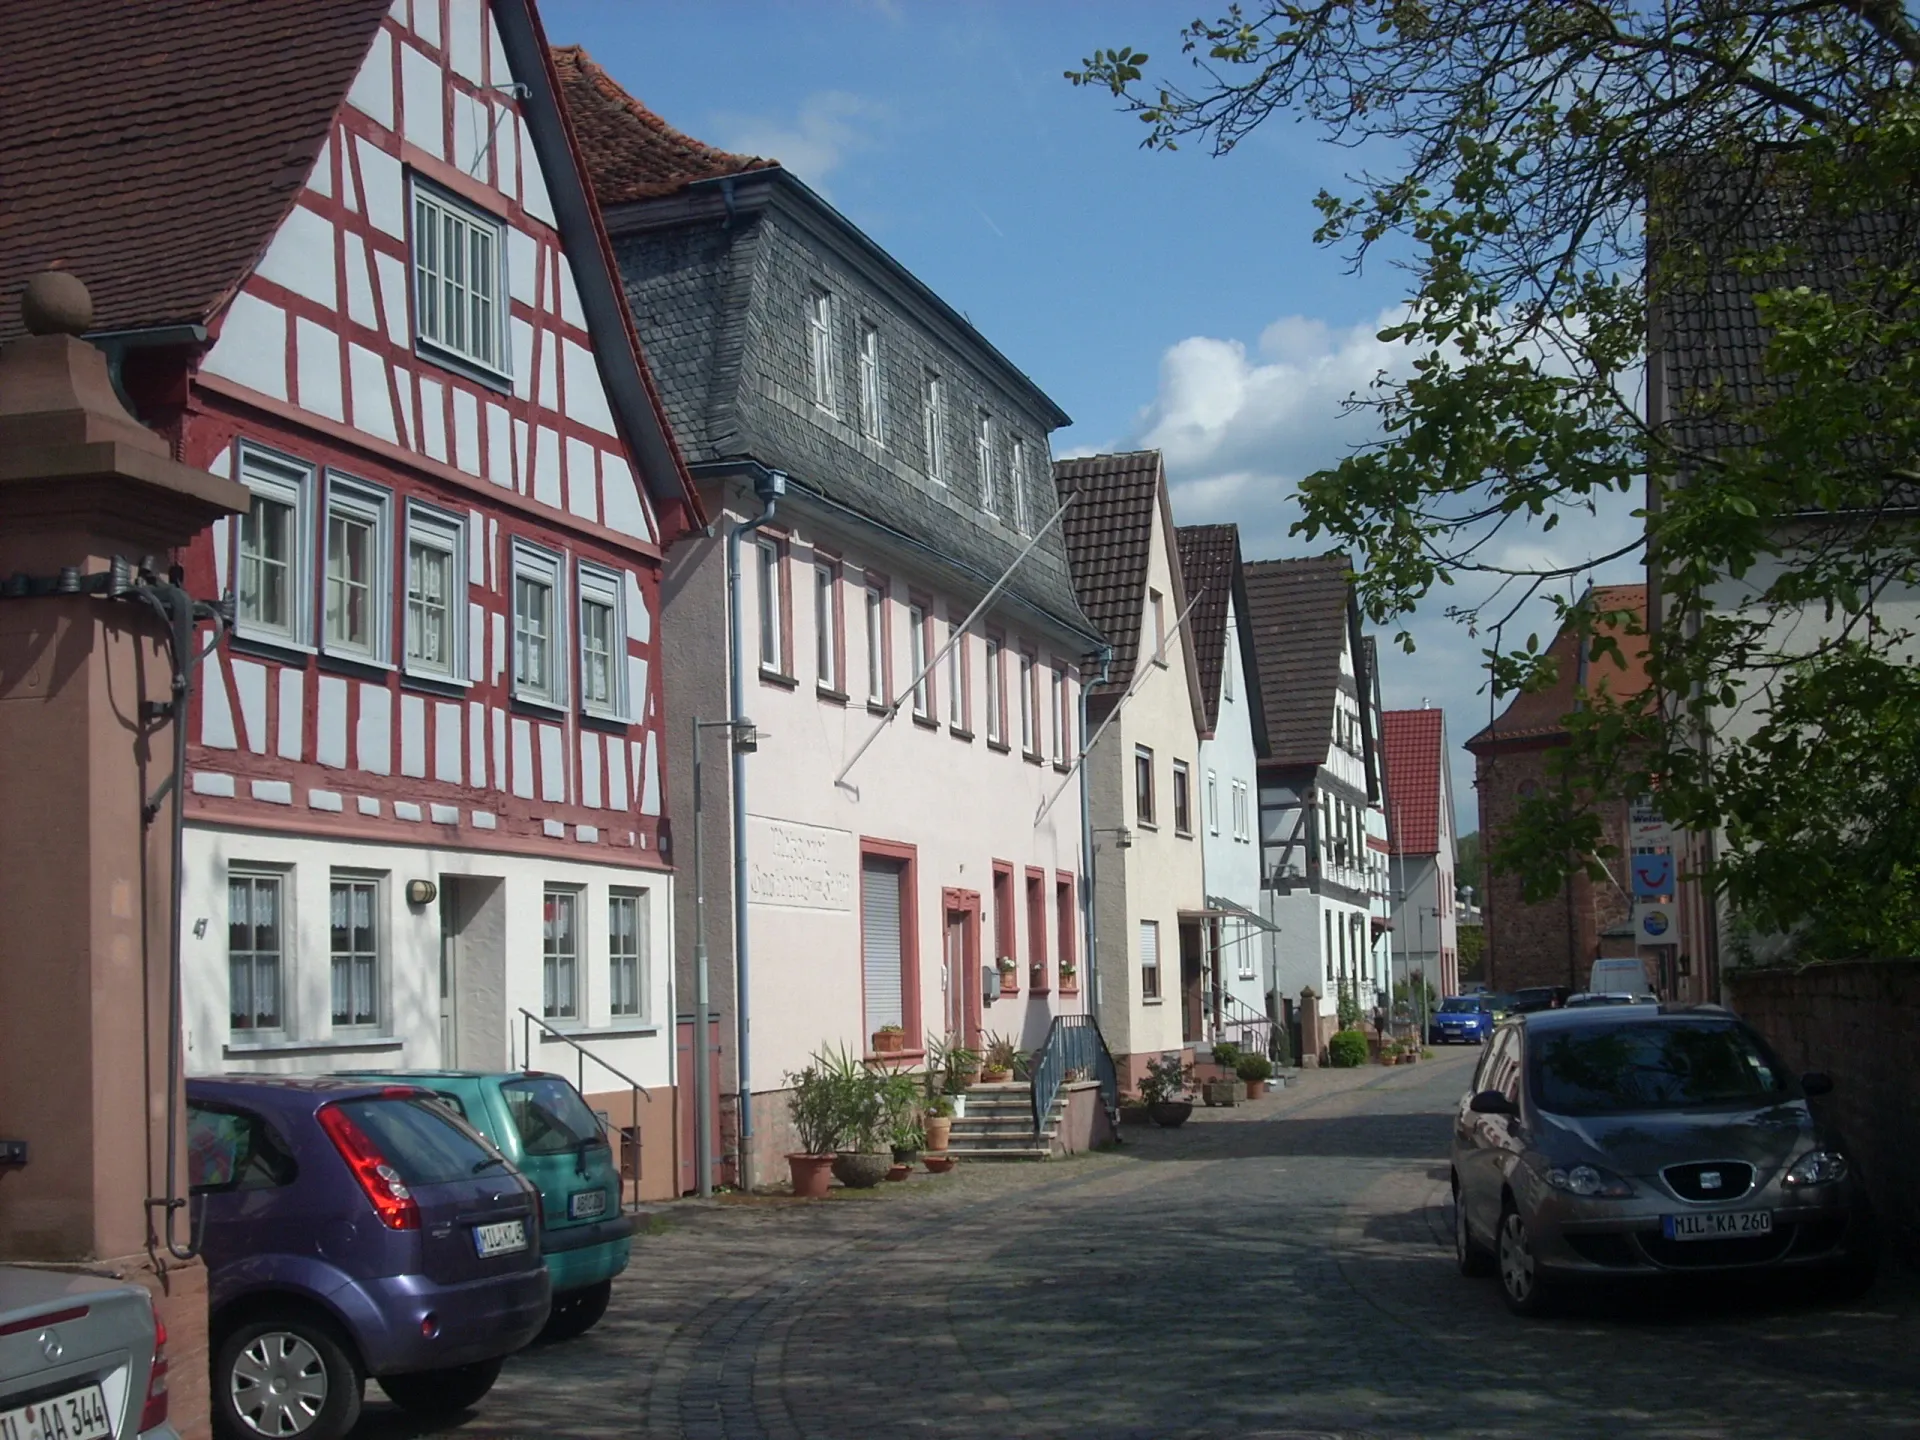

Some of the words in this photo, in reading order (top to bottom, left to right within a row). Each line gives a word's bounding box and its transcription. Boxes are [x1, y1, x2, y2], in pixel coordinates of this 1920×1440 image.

[1675, 1215, 1705, 1234] MIL
[1716, 1214, 1737, 1232] KA
[1741, 1213, 1769, 1231] 260
[40, 1403, 68, 1440] AA
[66, 1392, 104, 1436] 344
